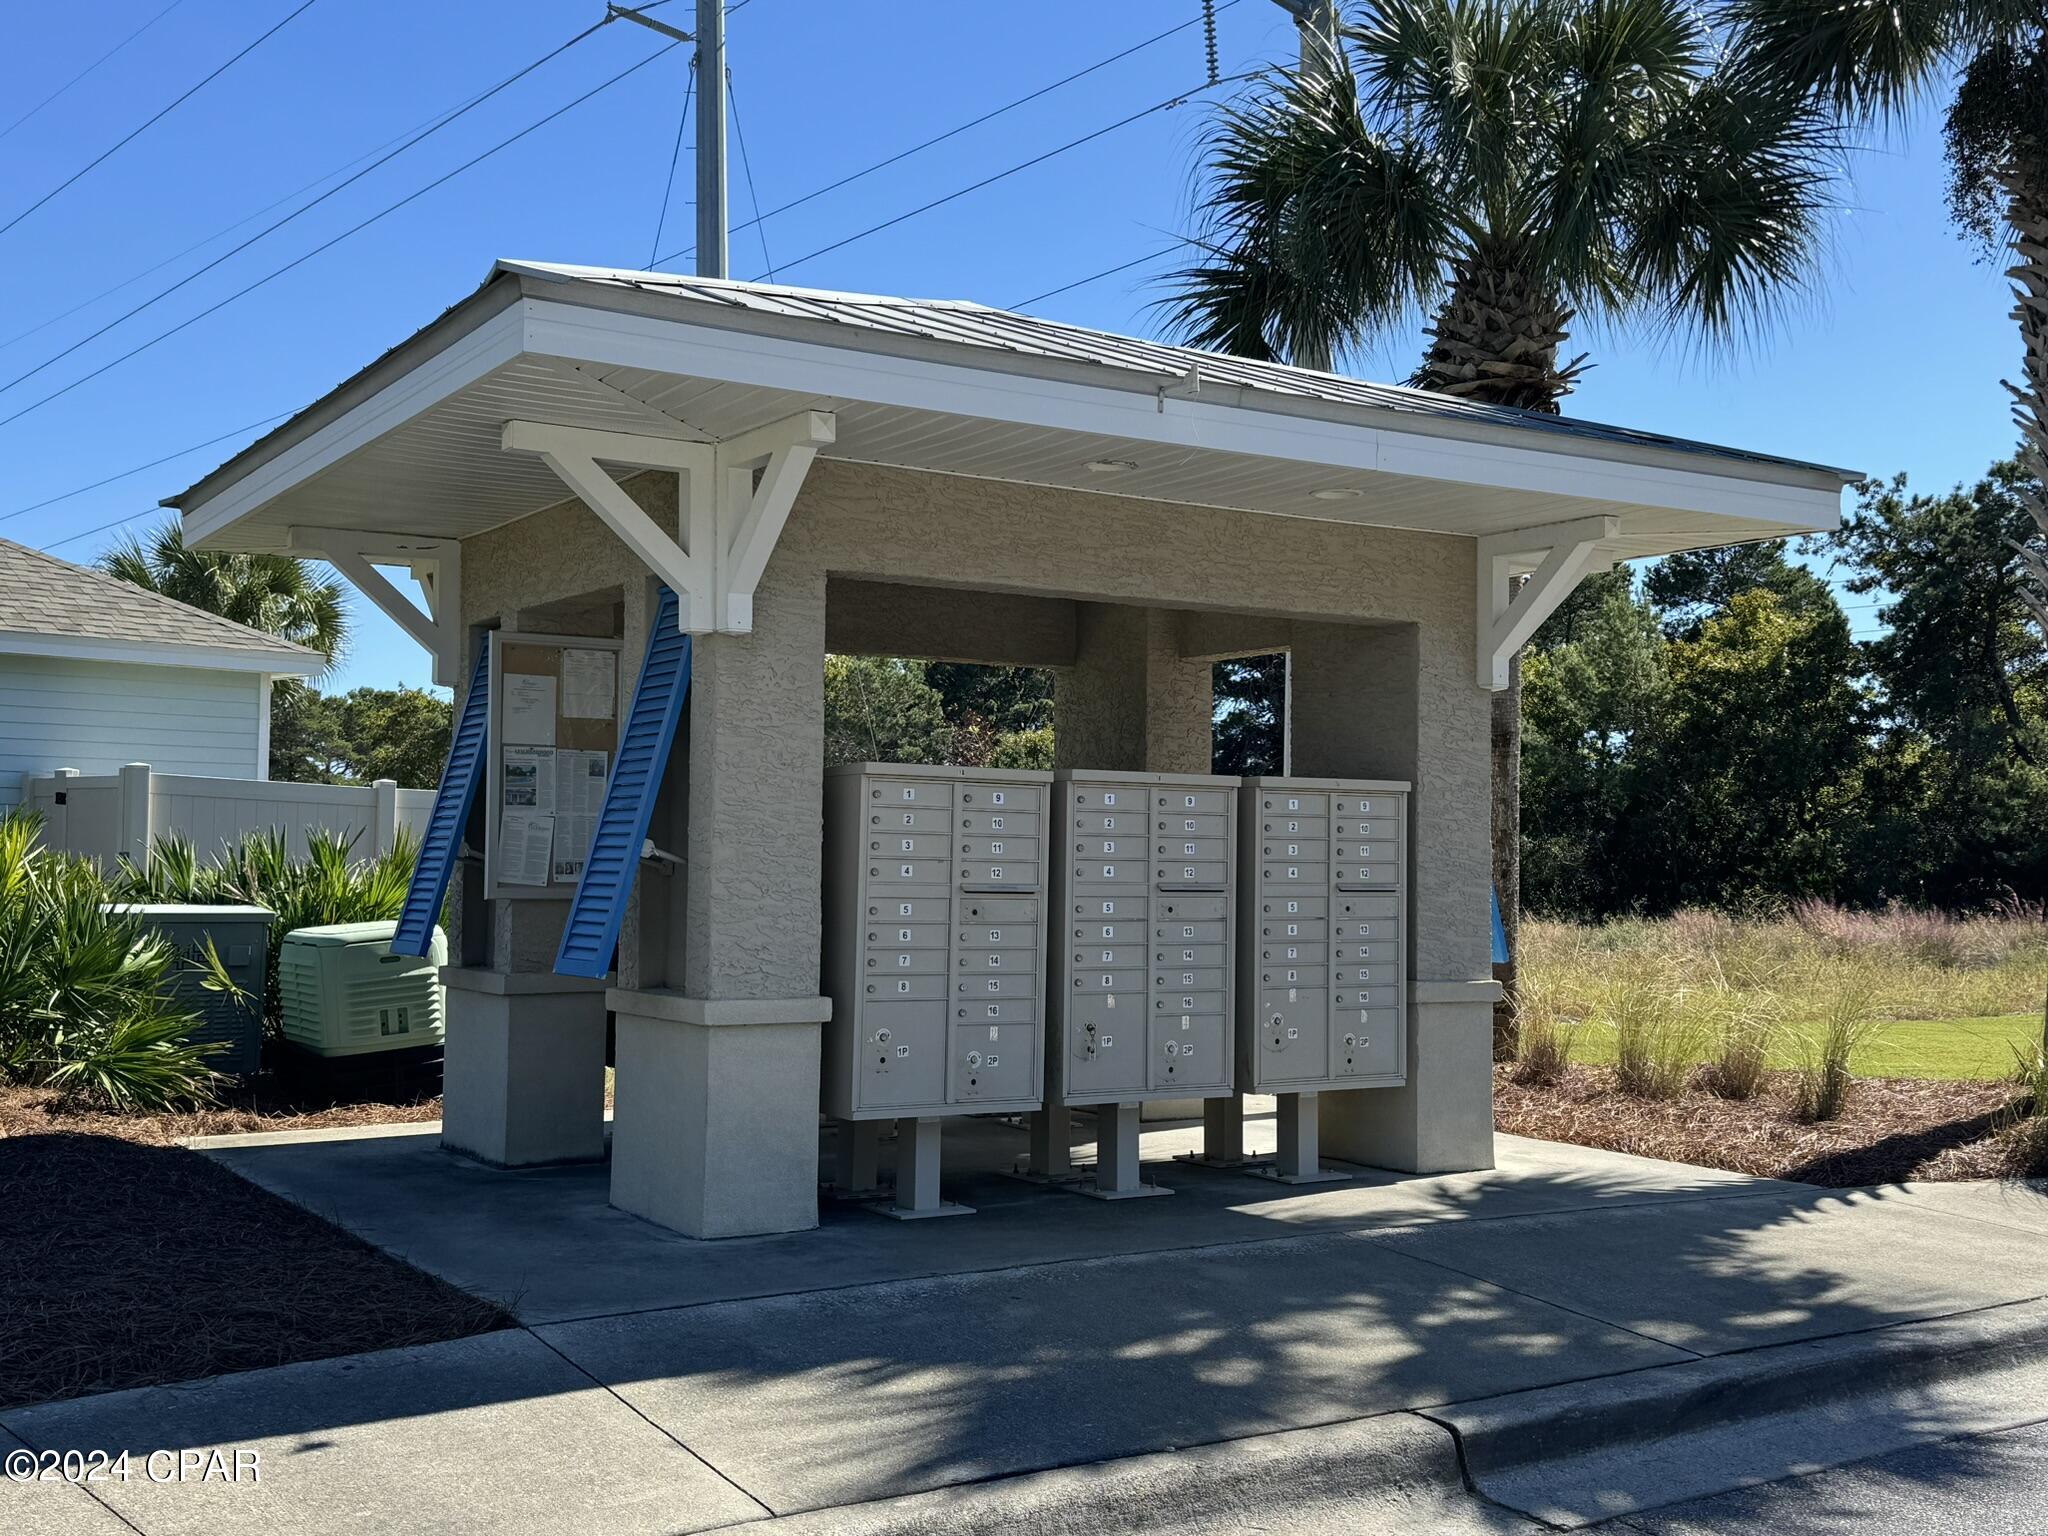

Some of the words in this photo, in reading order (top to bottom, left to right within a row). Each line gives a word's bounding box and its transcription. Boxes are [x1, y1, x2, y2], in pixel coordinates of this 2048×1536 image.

[992, 819, 1003, 828] 10
[1185, 821, 1195, 830] 10
[1361, 824, 1369, 833] 10
[992, 843, 1002, 853] 11
[1185, 845, 1194, 853] 11
[1361, 847, 1369, 855] 11
[991, 868, 1001, 878] 12
[1185, 868, 1194, 877] 12
[1361, 869, 1369, 878] 12
[990, 931, 1000, 940] 13
[1184, 927, 1193, 936] 13
[1184, 951, 1193, 960] 14
[989, 956, 999, 965] 14
[1183, 974, 1193, 983] 15
[1360, 970, 1368, 978] 15
[989, 981, 999, 990] 15
[1360, 993, 1368, 1001] 16
[1184, 998, 1193, 1007] 16
[988, 1006, 998, 1016] 16
[1288, 1029, 1297, 1038] 1P
[1103, 1037, 1112, 1046] 1P
[1359, 1038, 1368, 1046] 2P
[897, 1047, 908, 1056] 1P
[1183, 1045, 1193, 1055] 2P
[987, 1056, 998, 1066] 2P
